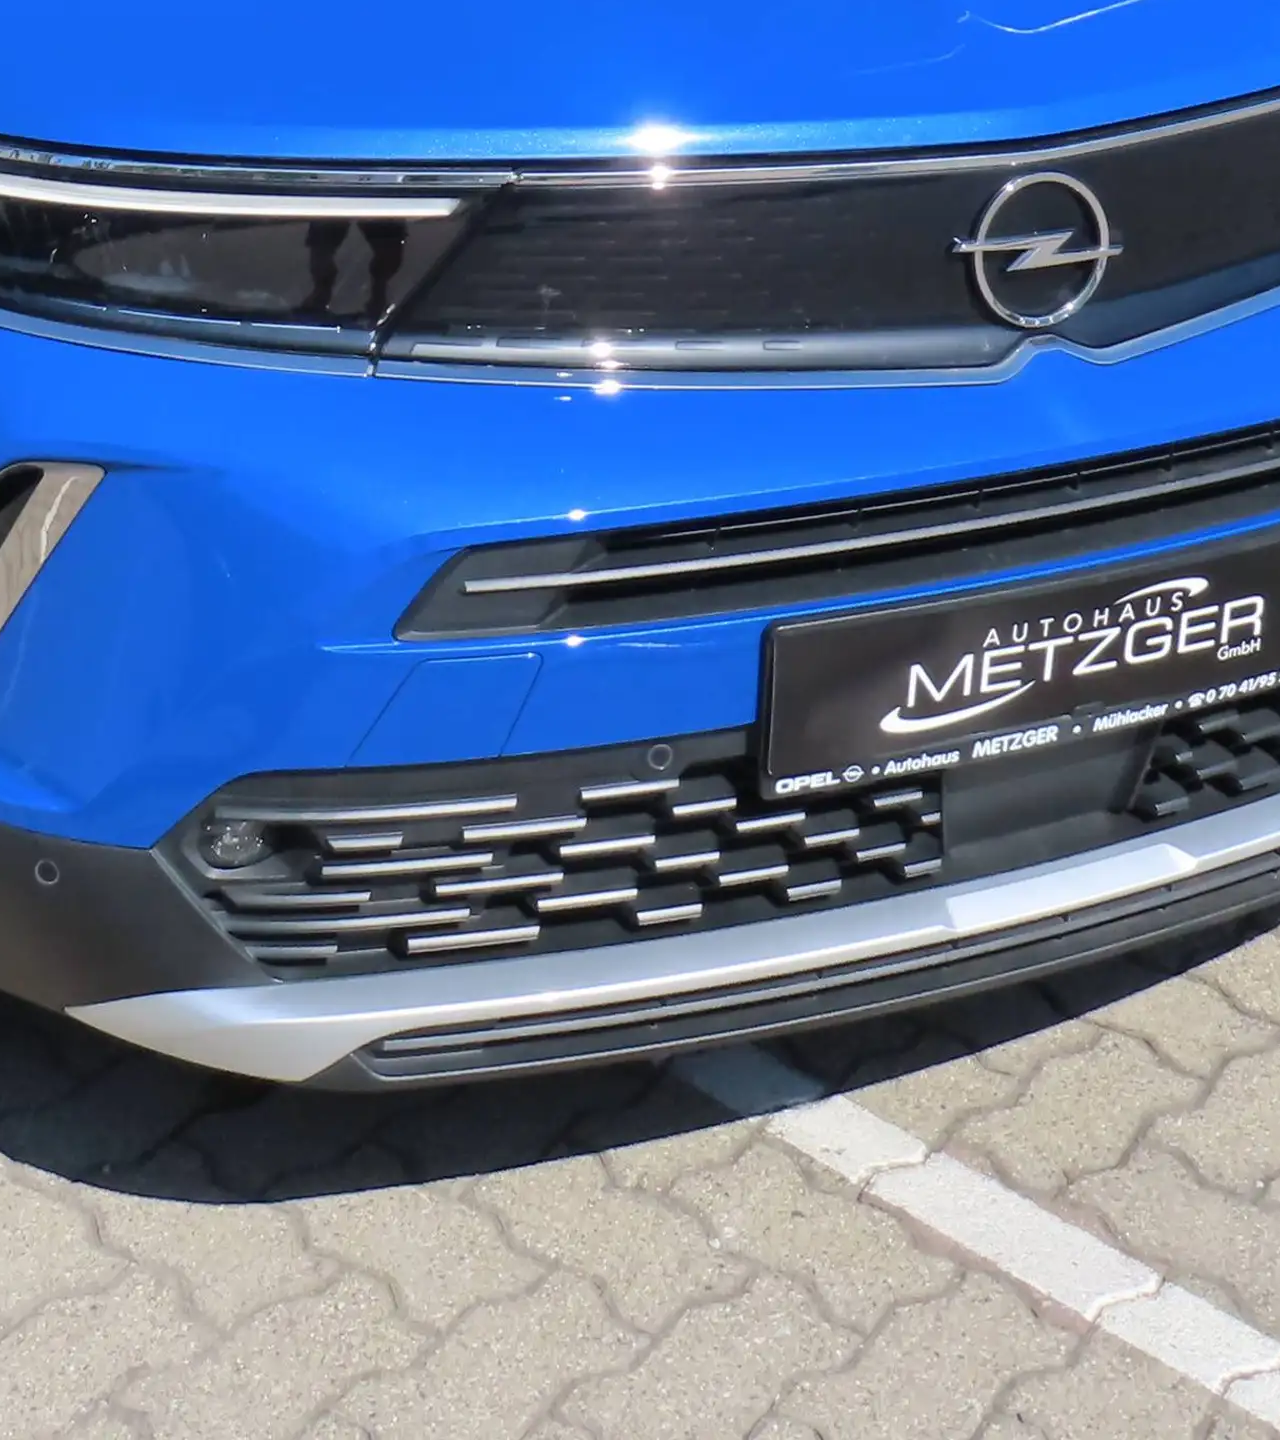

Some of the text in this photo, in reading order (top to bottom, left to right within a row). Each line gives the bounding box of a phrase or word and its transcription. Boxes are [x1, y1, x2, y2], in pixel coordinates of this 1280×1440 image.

[907, 595, 1265, 708] METZGER
[983, 592, 1184, 647] AUTOHAUS
[1217, 639, 1262, 661] GmbH
[775, 771, 841, 795] OPEL
[883, 749, 960, 776] Autohaus
[971, 724, 1060, 759] METZGER
[1093, 702, 1168, 732] Mühlacker
